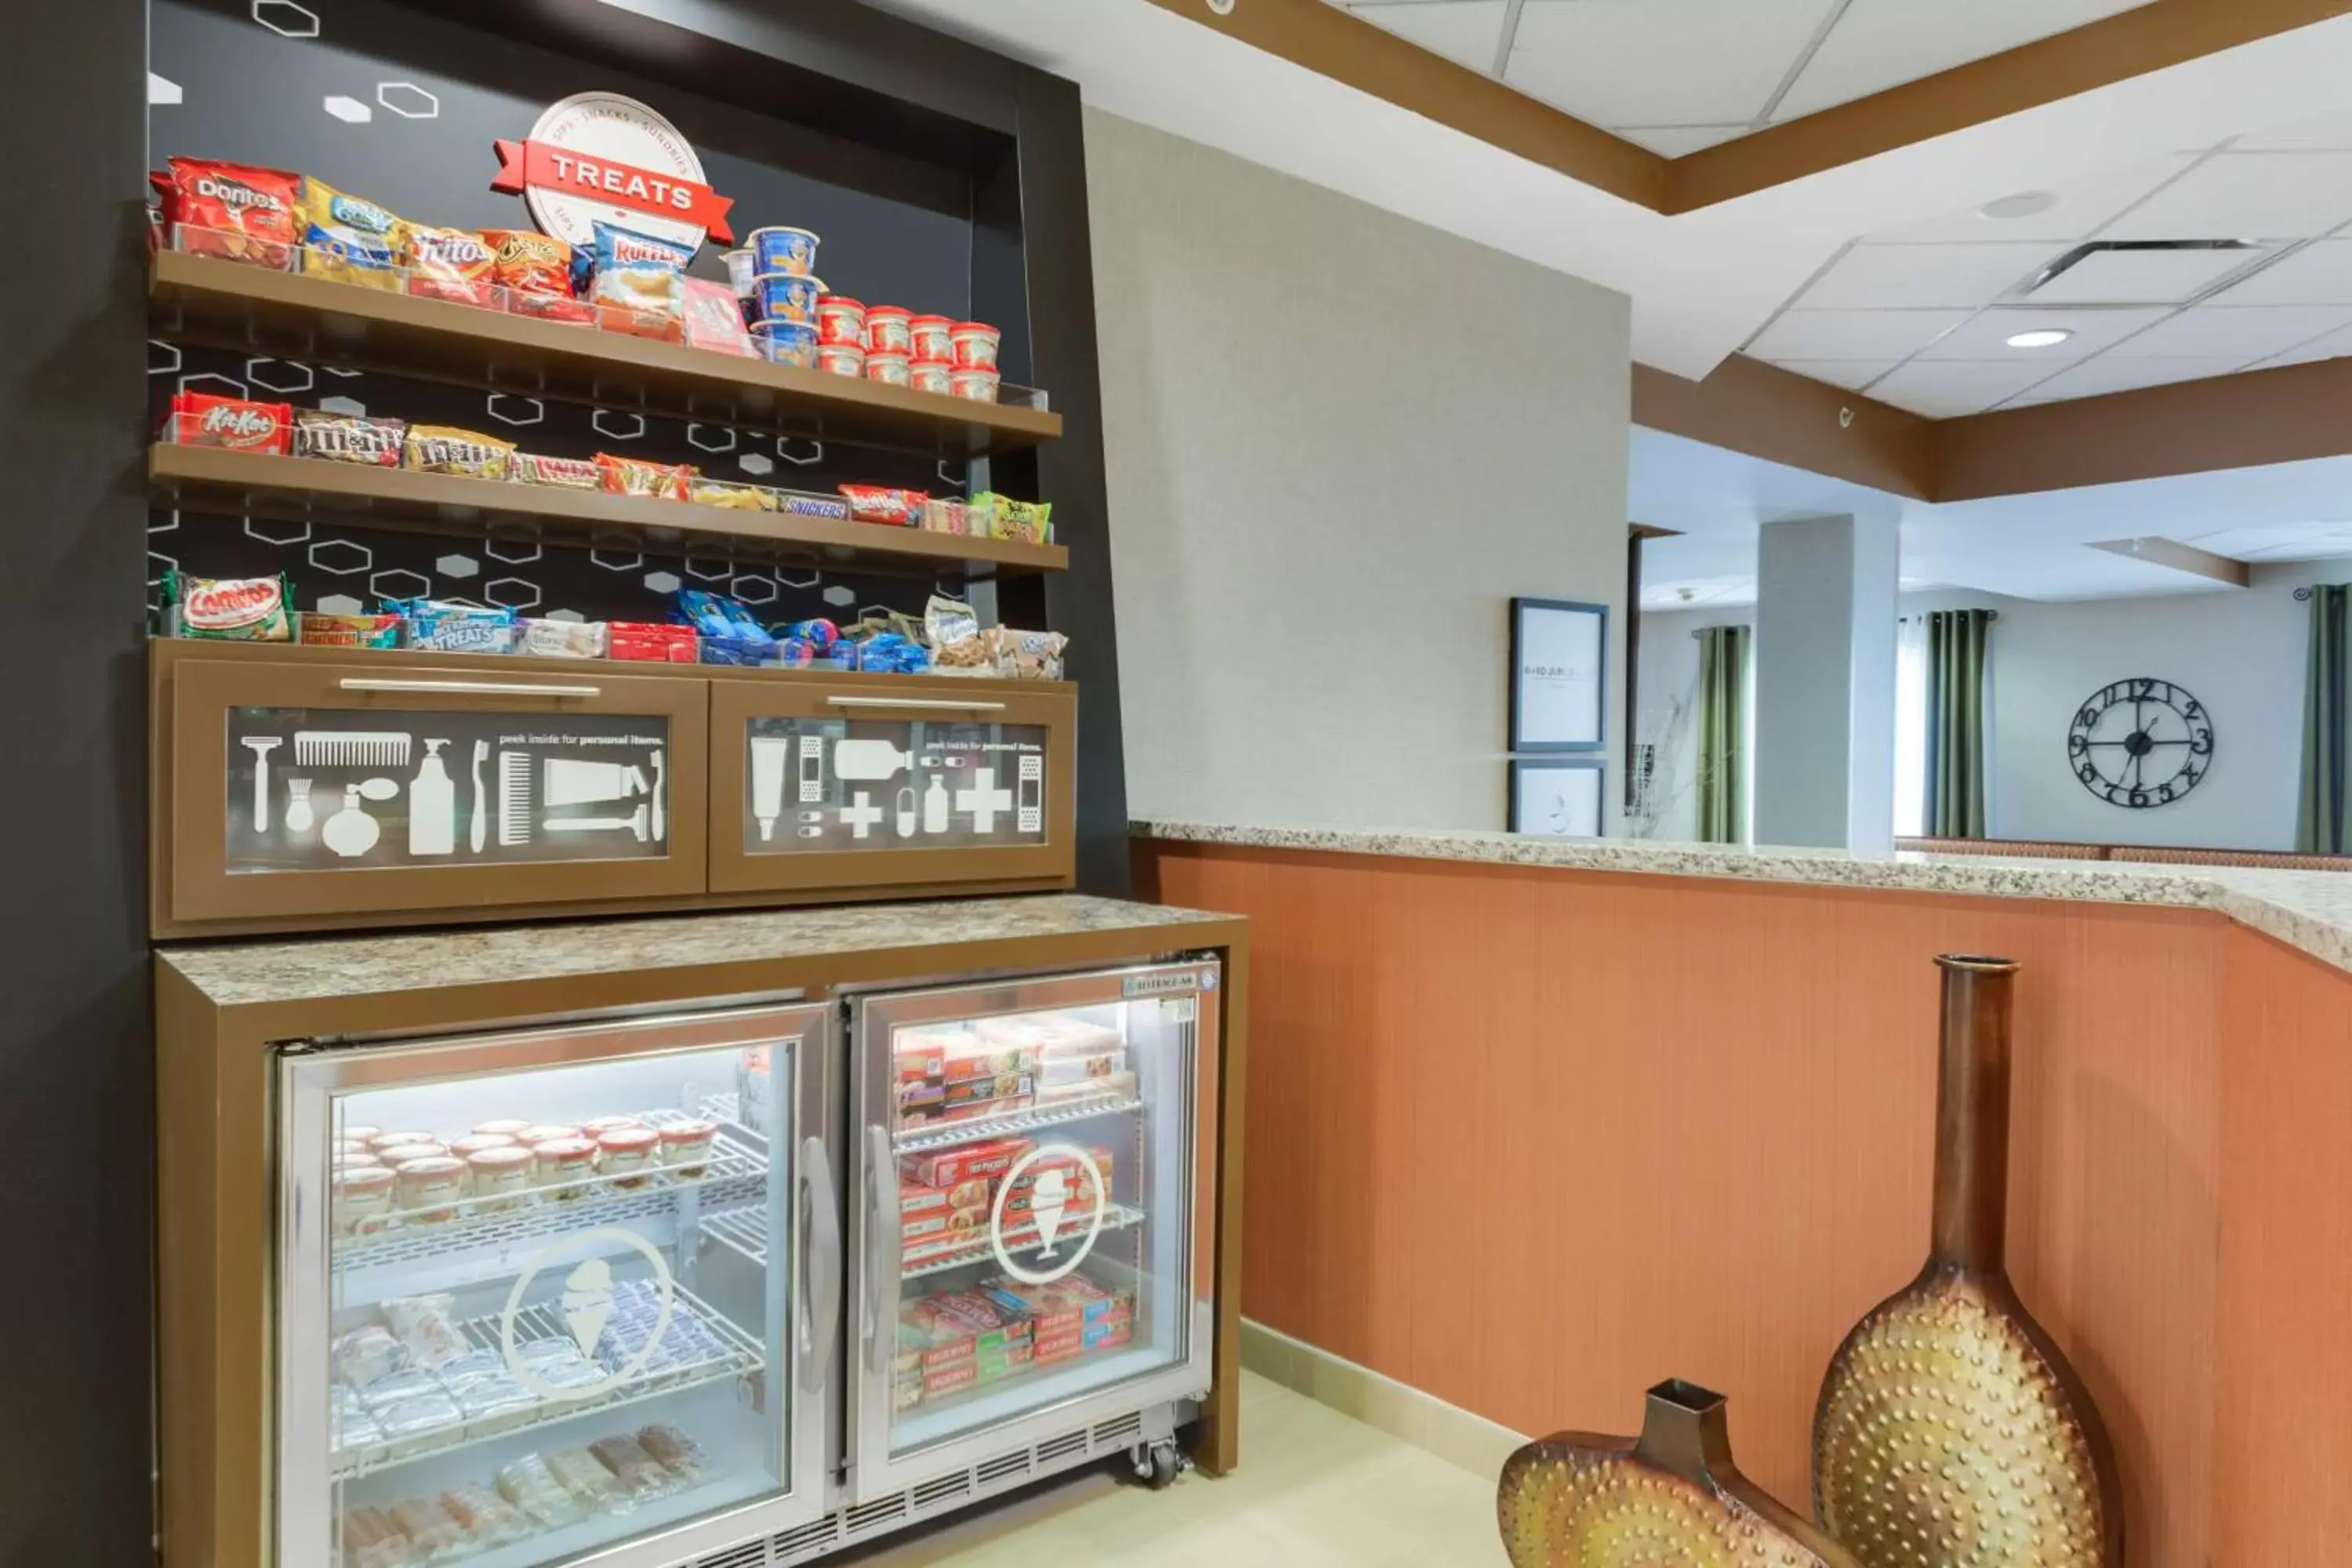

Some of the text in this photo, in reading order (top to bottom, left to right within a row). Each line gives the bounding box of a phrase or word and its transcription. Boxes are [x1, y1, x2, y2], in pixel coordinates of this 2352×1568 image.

[583, 108, 630, 123] SNACKS
[641, 121, 688, 175] SUNDRIES
[551, 154, 692, 209] TREATS
[198, 179, 280, 211] Doritos
[790, 500, 846, 520] SNICKERS
[435, 626, 493, 651] TREATS
[2103, 685, 2116, 709] 11
[2127, 678, 2156, 702] 12
[2076, 708, 2099, 728] 10
[2183, 700, 2199, 720] 2
[499, 735, 526, 746] peek
[528, 734, 559, 744] inside
[561, 734, 577, 744] for
[579, 735, 628, 746] personal
[982, 742, 1018, 752] personal
[2070, 734, 2088, 758] 9
[2191, 728, 2212, 754] 3
[2080, 762, 2096, 784] 8
[2180, 762, 2198, 786] 4
[2104, 783, 2119, 801] 7
[2128, 782, 2149, 808] 6
[2158, 782, 2173, 804] 5
